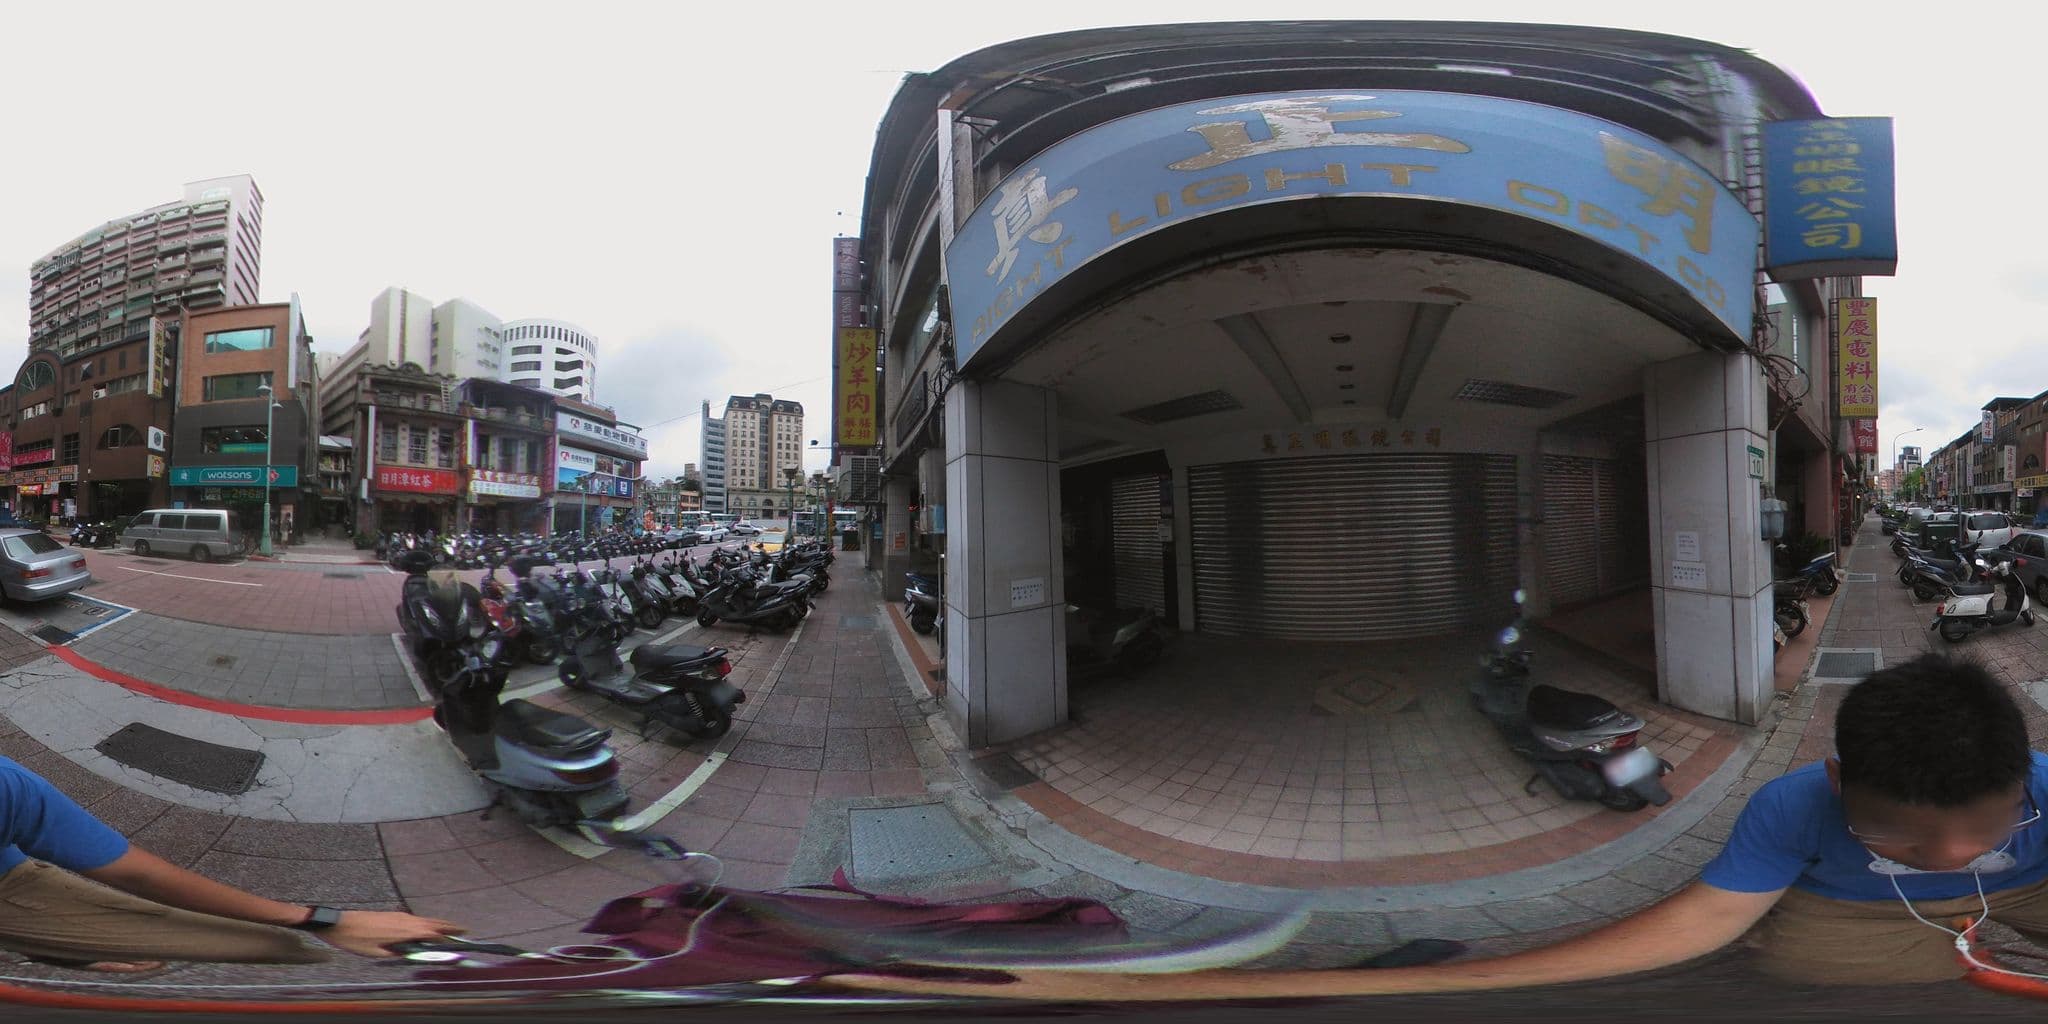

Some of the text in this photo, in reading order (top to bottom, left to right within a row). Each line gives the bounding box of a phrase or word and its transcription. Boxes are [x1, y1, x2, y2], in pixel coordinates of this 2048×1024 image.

[1108, 162, 1440, 238] LIGHT
[1843, 299, 1874, 381] 豐慶電料
[845, 342, 872, 414] 炒羊肉
[207, 470, 253, 480] watsons
[380, 472, 433, 488] 日月潭紅茶
[1752, 459, 1761, 474] 10
